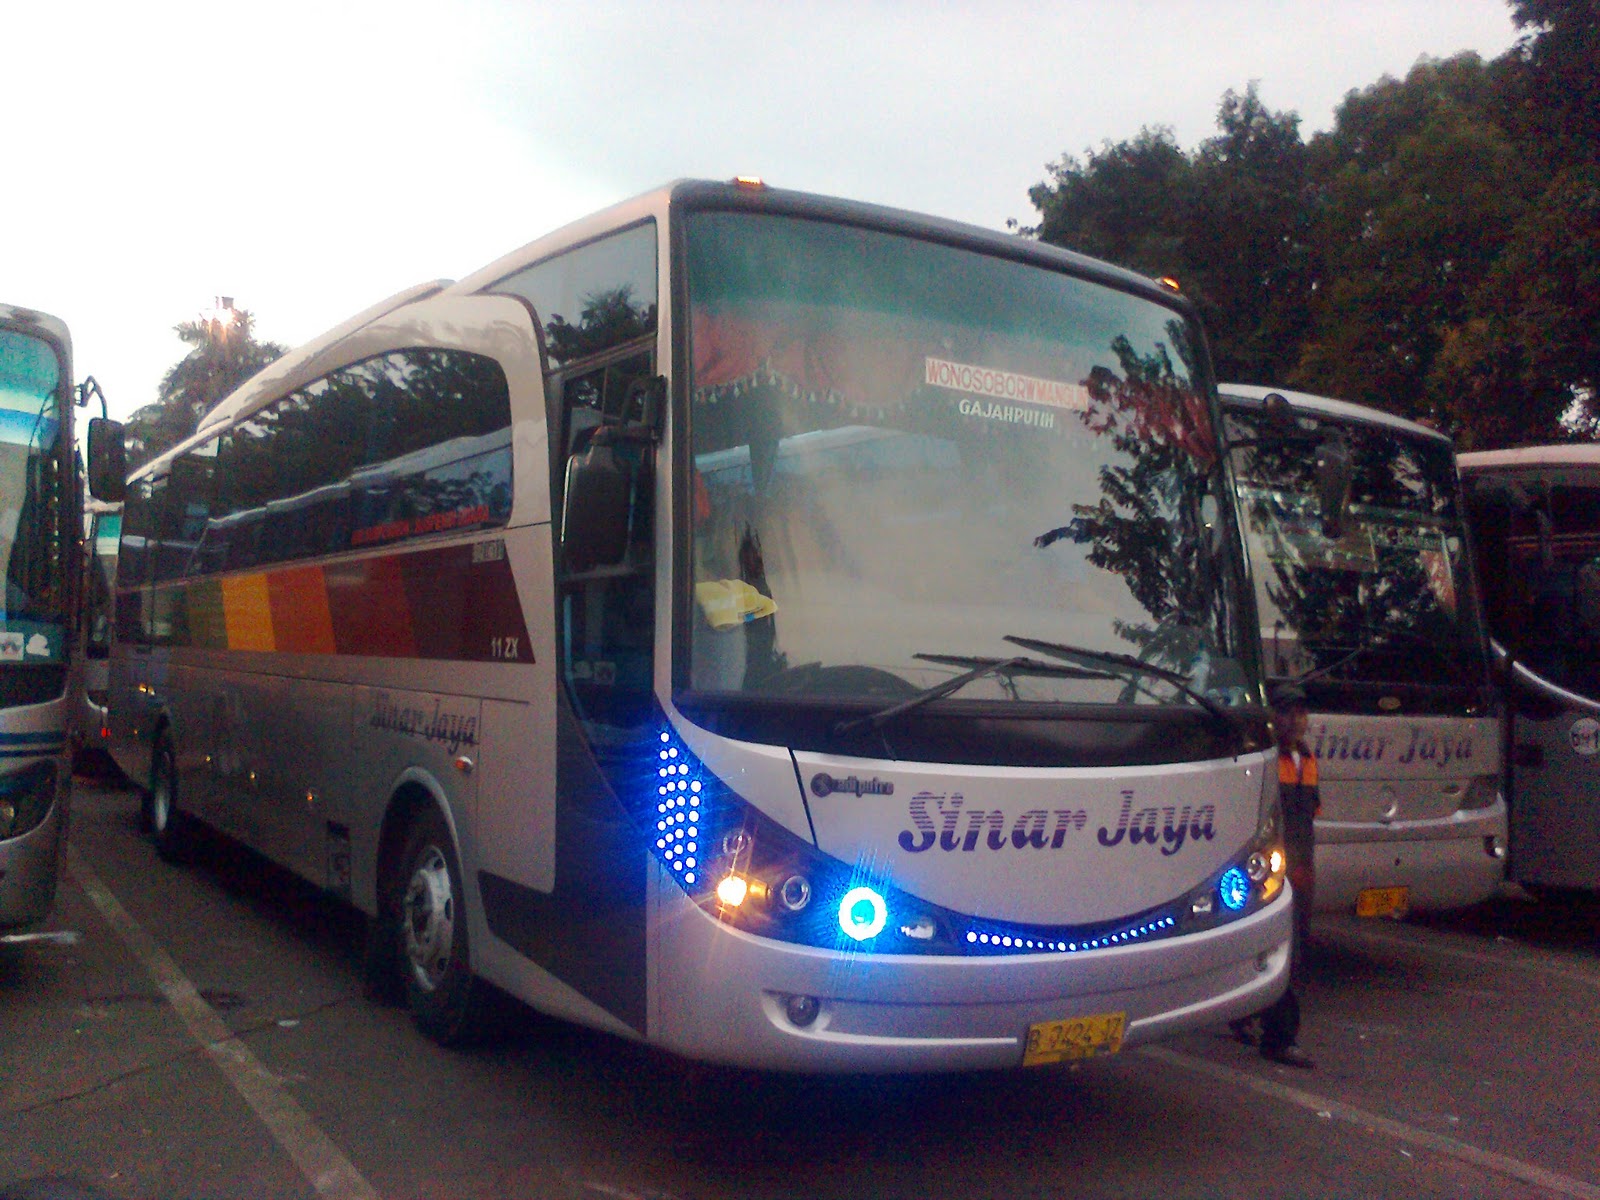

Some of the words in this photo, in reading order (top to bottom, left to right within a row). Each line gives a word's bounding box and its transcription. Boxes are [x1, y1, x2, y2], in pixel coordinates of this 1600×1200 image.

[1309, 723, 1387, 760] inar
[898, 789, 1088, 854] Sinar
[1097, 788, 1217, 857] Jaya
